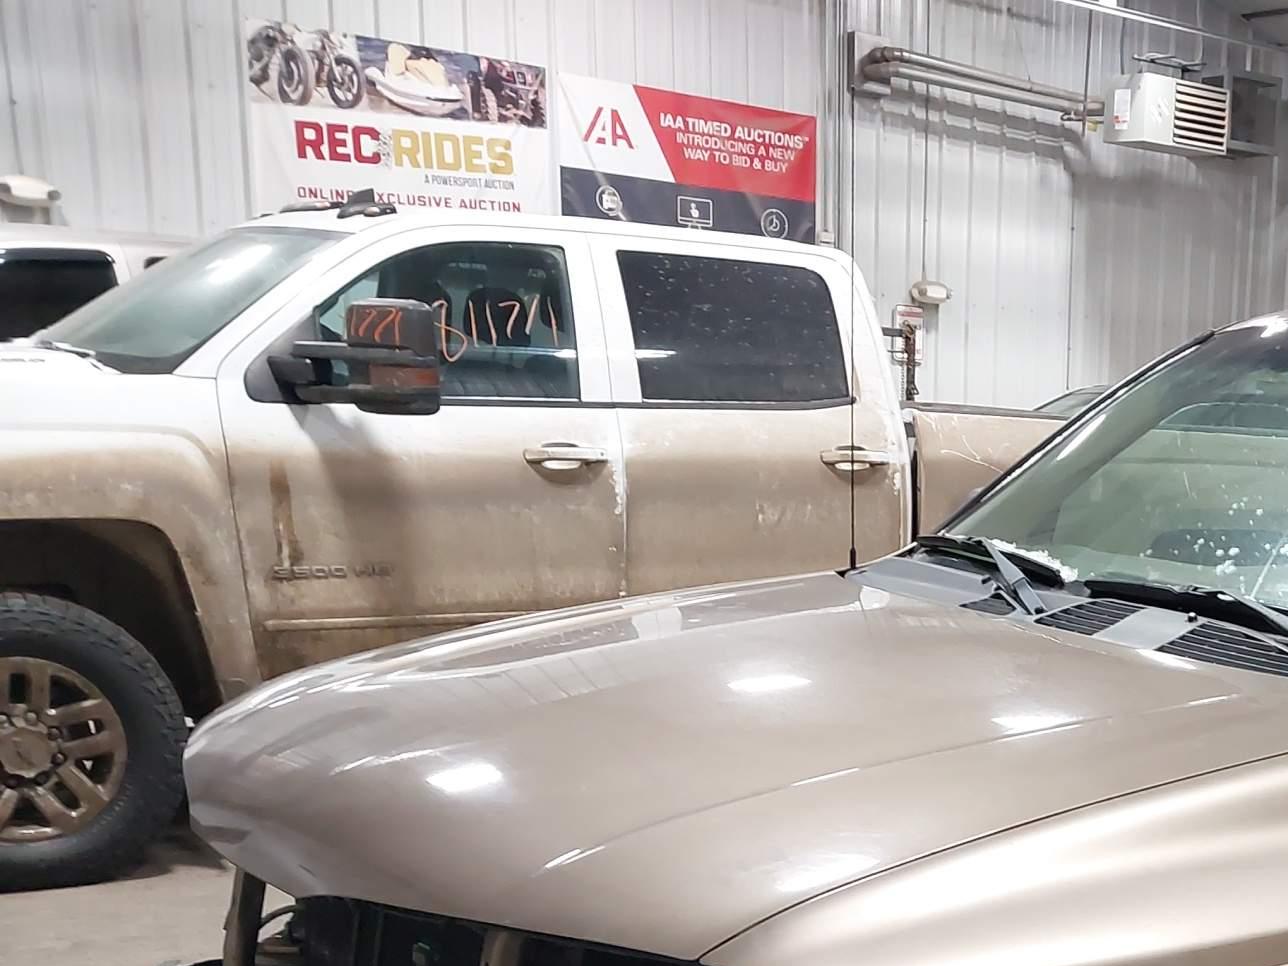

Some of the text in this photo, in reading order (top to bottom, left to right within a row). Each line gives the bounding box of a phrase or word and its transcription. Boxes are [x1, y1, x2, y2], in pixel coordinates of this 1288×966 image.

[659, 112, 685, 130] IAA
[686, 117, 731, 137] TIMED
[293, 119, 514, 176] REC RIDES
[676, 132, 795, 160] INTRODUCING A NEW
[683, 146, 788, 173] WAY TO BID & BUY
[424, 173, 515, 191] A POWERSPORT AUCTION
[375, 190, 453, 209] XCLUSIVE
[459, 198, 521, 213] AUCTION
